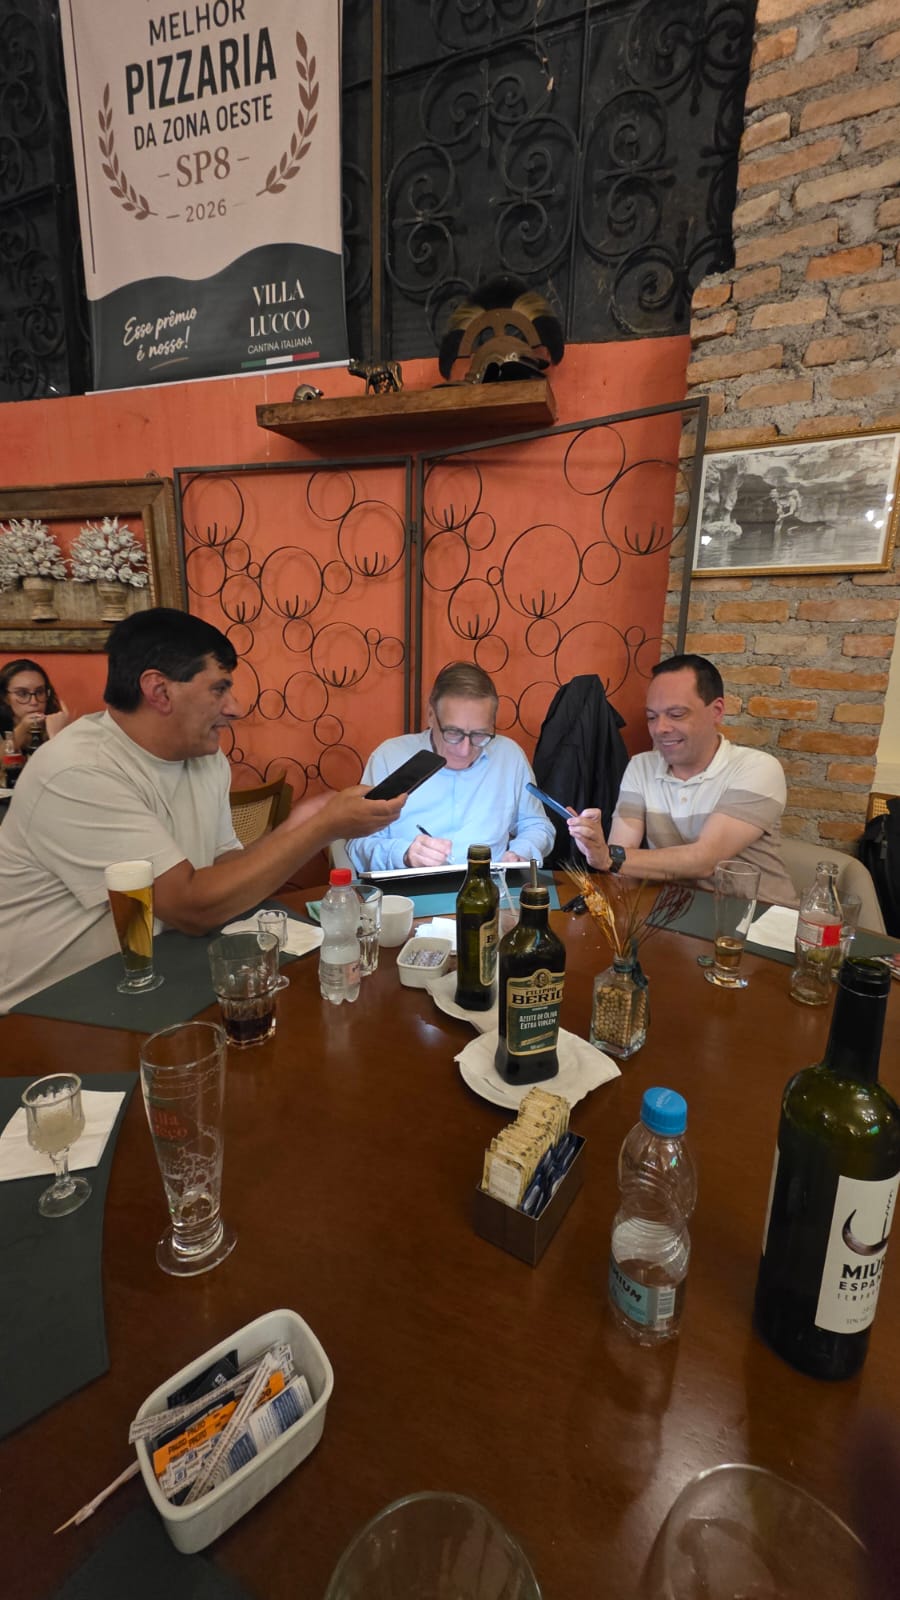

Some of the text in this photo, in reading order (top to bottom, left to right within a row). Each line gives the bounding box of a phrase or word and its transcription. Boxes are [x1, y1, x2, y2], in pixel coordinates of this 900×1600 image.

[148, 0, 246, 46] MELHOR
[125, 26, 277, 116] PIZZARIA
[133, 93, 273, 151] DA ZONA OESTE
[176, 146, 231, 188] SP8
[185, 198, 227, 223] 2026
[252, 279, 305, 307] VILLA
[123, 307, 198, 346] Esse prêmio
[250, 308, 310, 337] LUCCO
[136, 326, 190, 362] é nosso!
[247, 335, 312, 354] CANTINA ITALIANA
